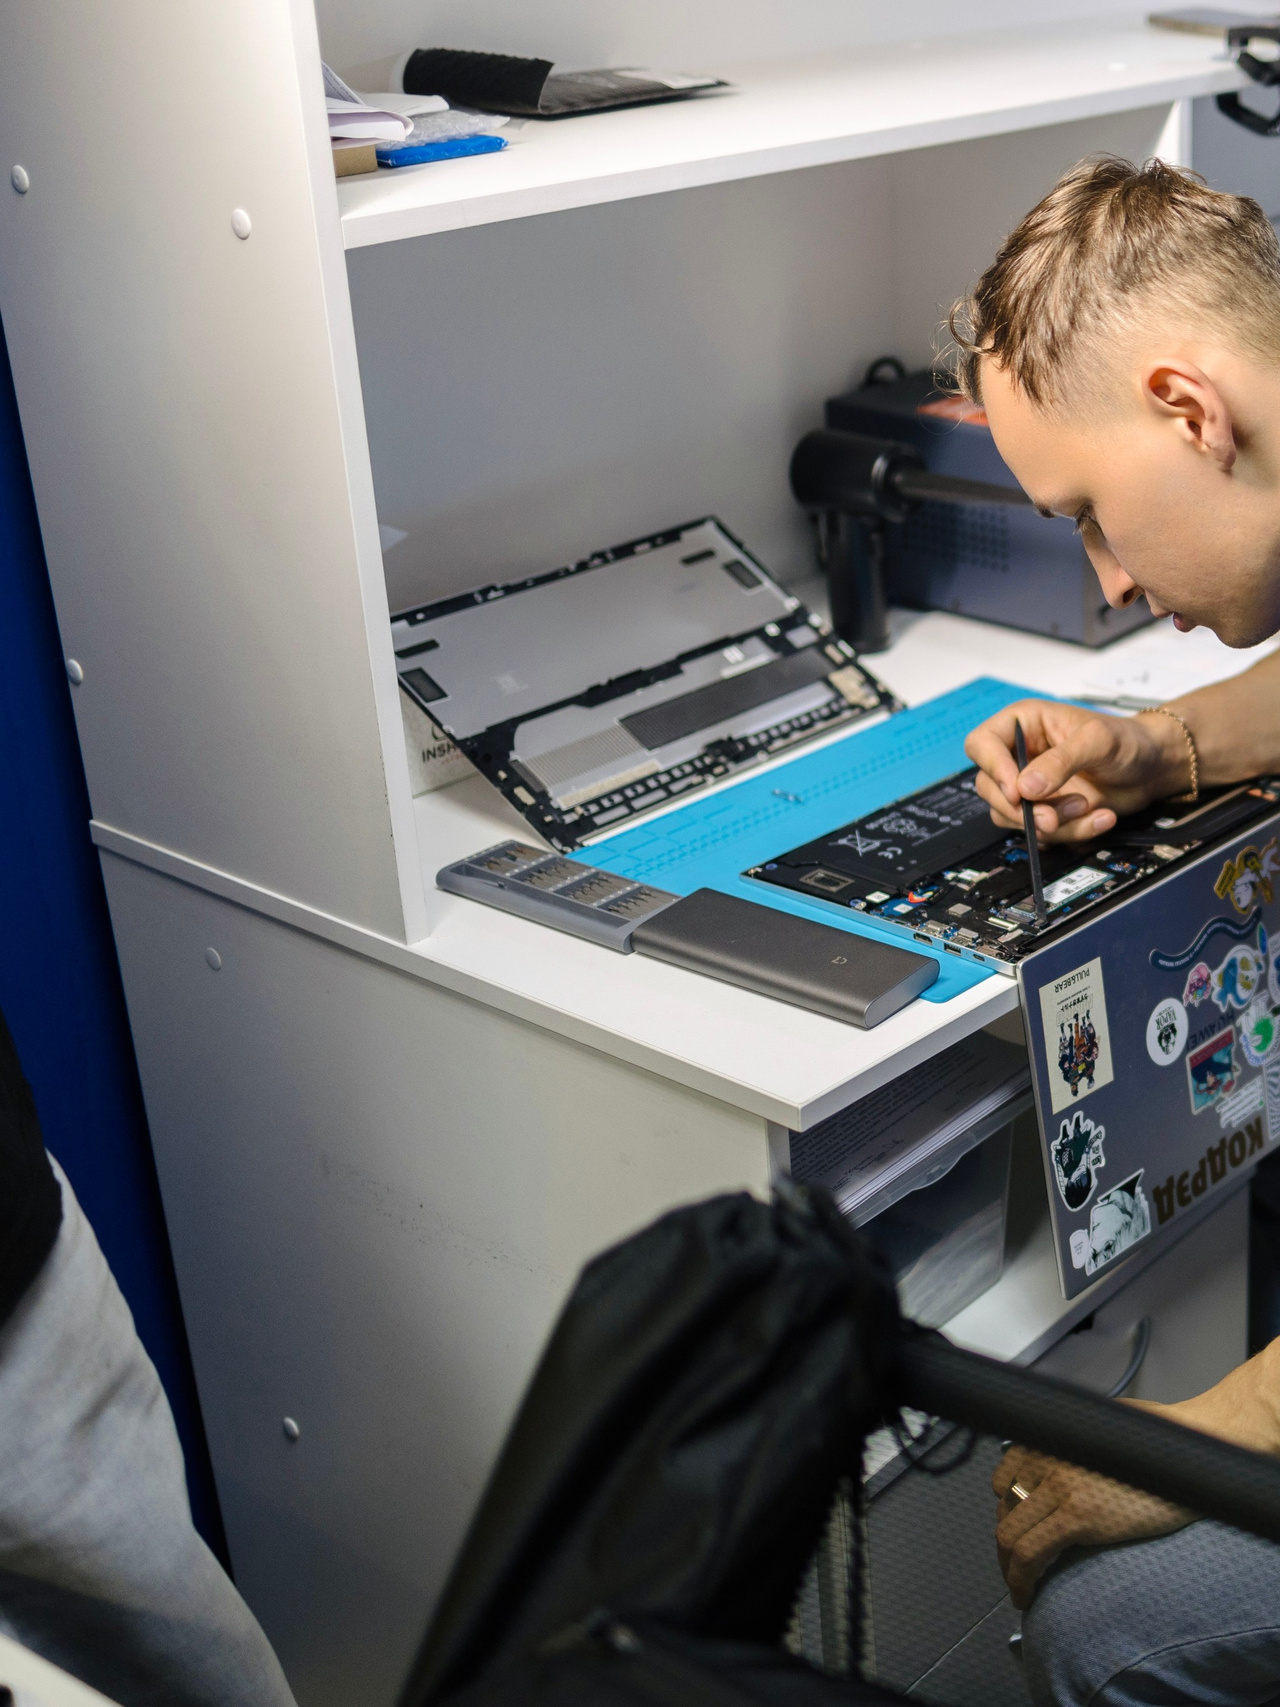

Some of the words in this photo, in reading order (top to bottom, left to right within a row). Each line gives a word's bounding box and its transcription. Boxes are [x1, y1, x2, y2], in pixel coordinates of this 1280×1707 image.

[1054, 967, 1090, 994] PULL&BEAR
[1155, 1009, 1177, 1031] VAPOR
[1186, 1010, 1234, 1051] HUAWEI
[1152, 1116, 1264, 1226] КОДРЭД
